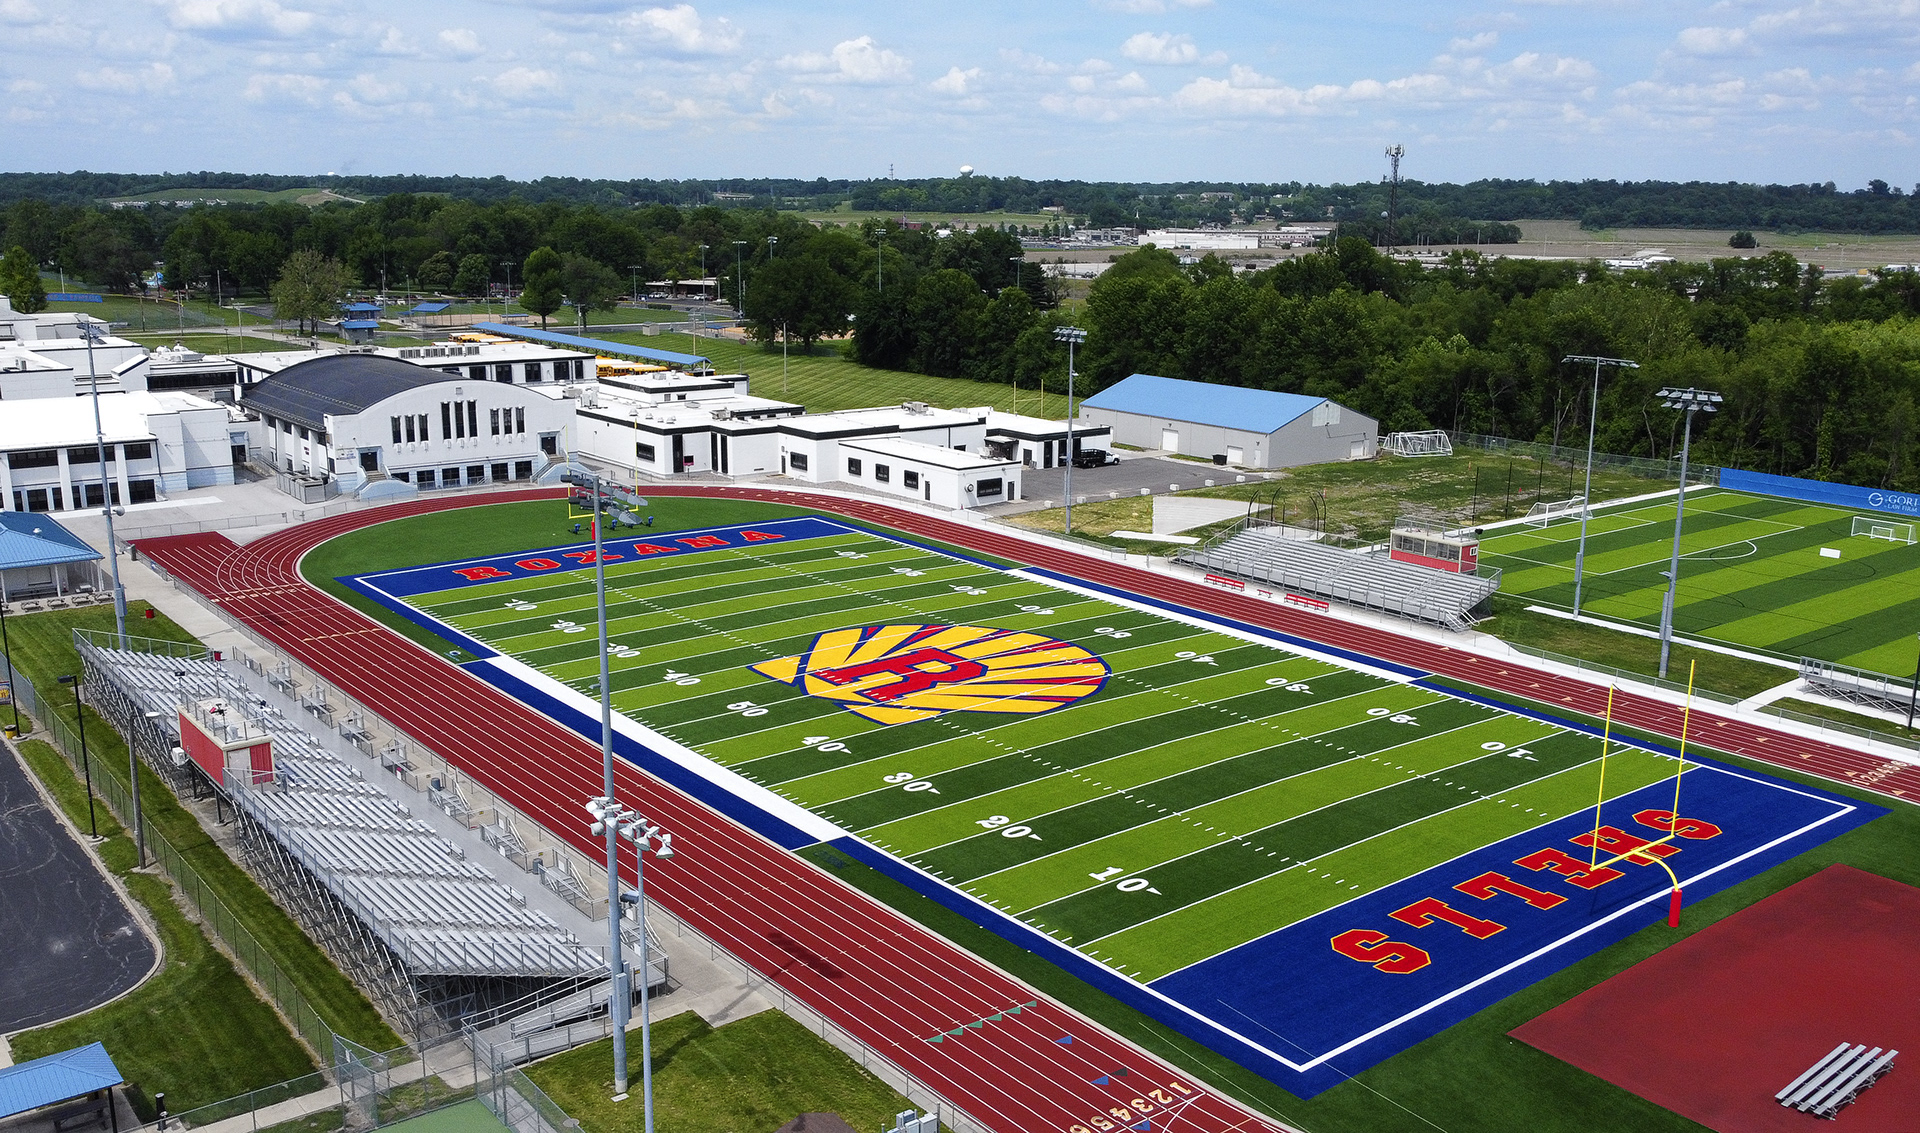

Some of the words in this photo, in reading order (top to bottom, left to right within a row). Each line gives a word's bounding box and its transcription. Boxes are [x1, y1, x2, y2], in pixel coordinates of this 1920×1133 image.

[1888, 495, 1918, 506] GORI
[452, 530, 785, 580] ROXANA
[504, 600, 538, 611] 10
[1093, 626, 1132, 639] 50
[1174, 651, 1214, 663] 40
[663, 672, 701, 686] 40
[815, 646, 988, 704] R
[1265, 677, 1310, 692] 30
[726, 700, 769, 717] 50
[1366, 708, 1417, 724] 20
[801, 736, 846, 752] 40
[1480, 741, 1533, 758] 10
[883, 772, 932, 792] 30
[975, 815, 1032, 838] 20
[1088, 866, 1149, 892] 10
[1330, 808, 1722, 974] SHELLS
[1169, 1082, 1192, 1095] 1
[1148, 1089, 1172, 1104] 2
[1131, 1098, 1154, 1113] 3
[1109, 1108, 1132, 1122] 4
[1090, 1116, 1115, 1131] 5
